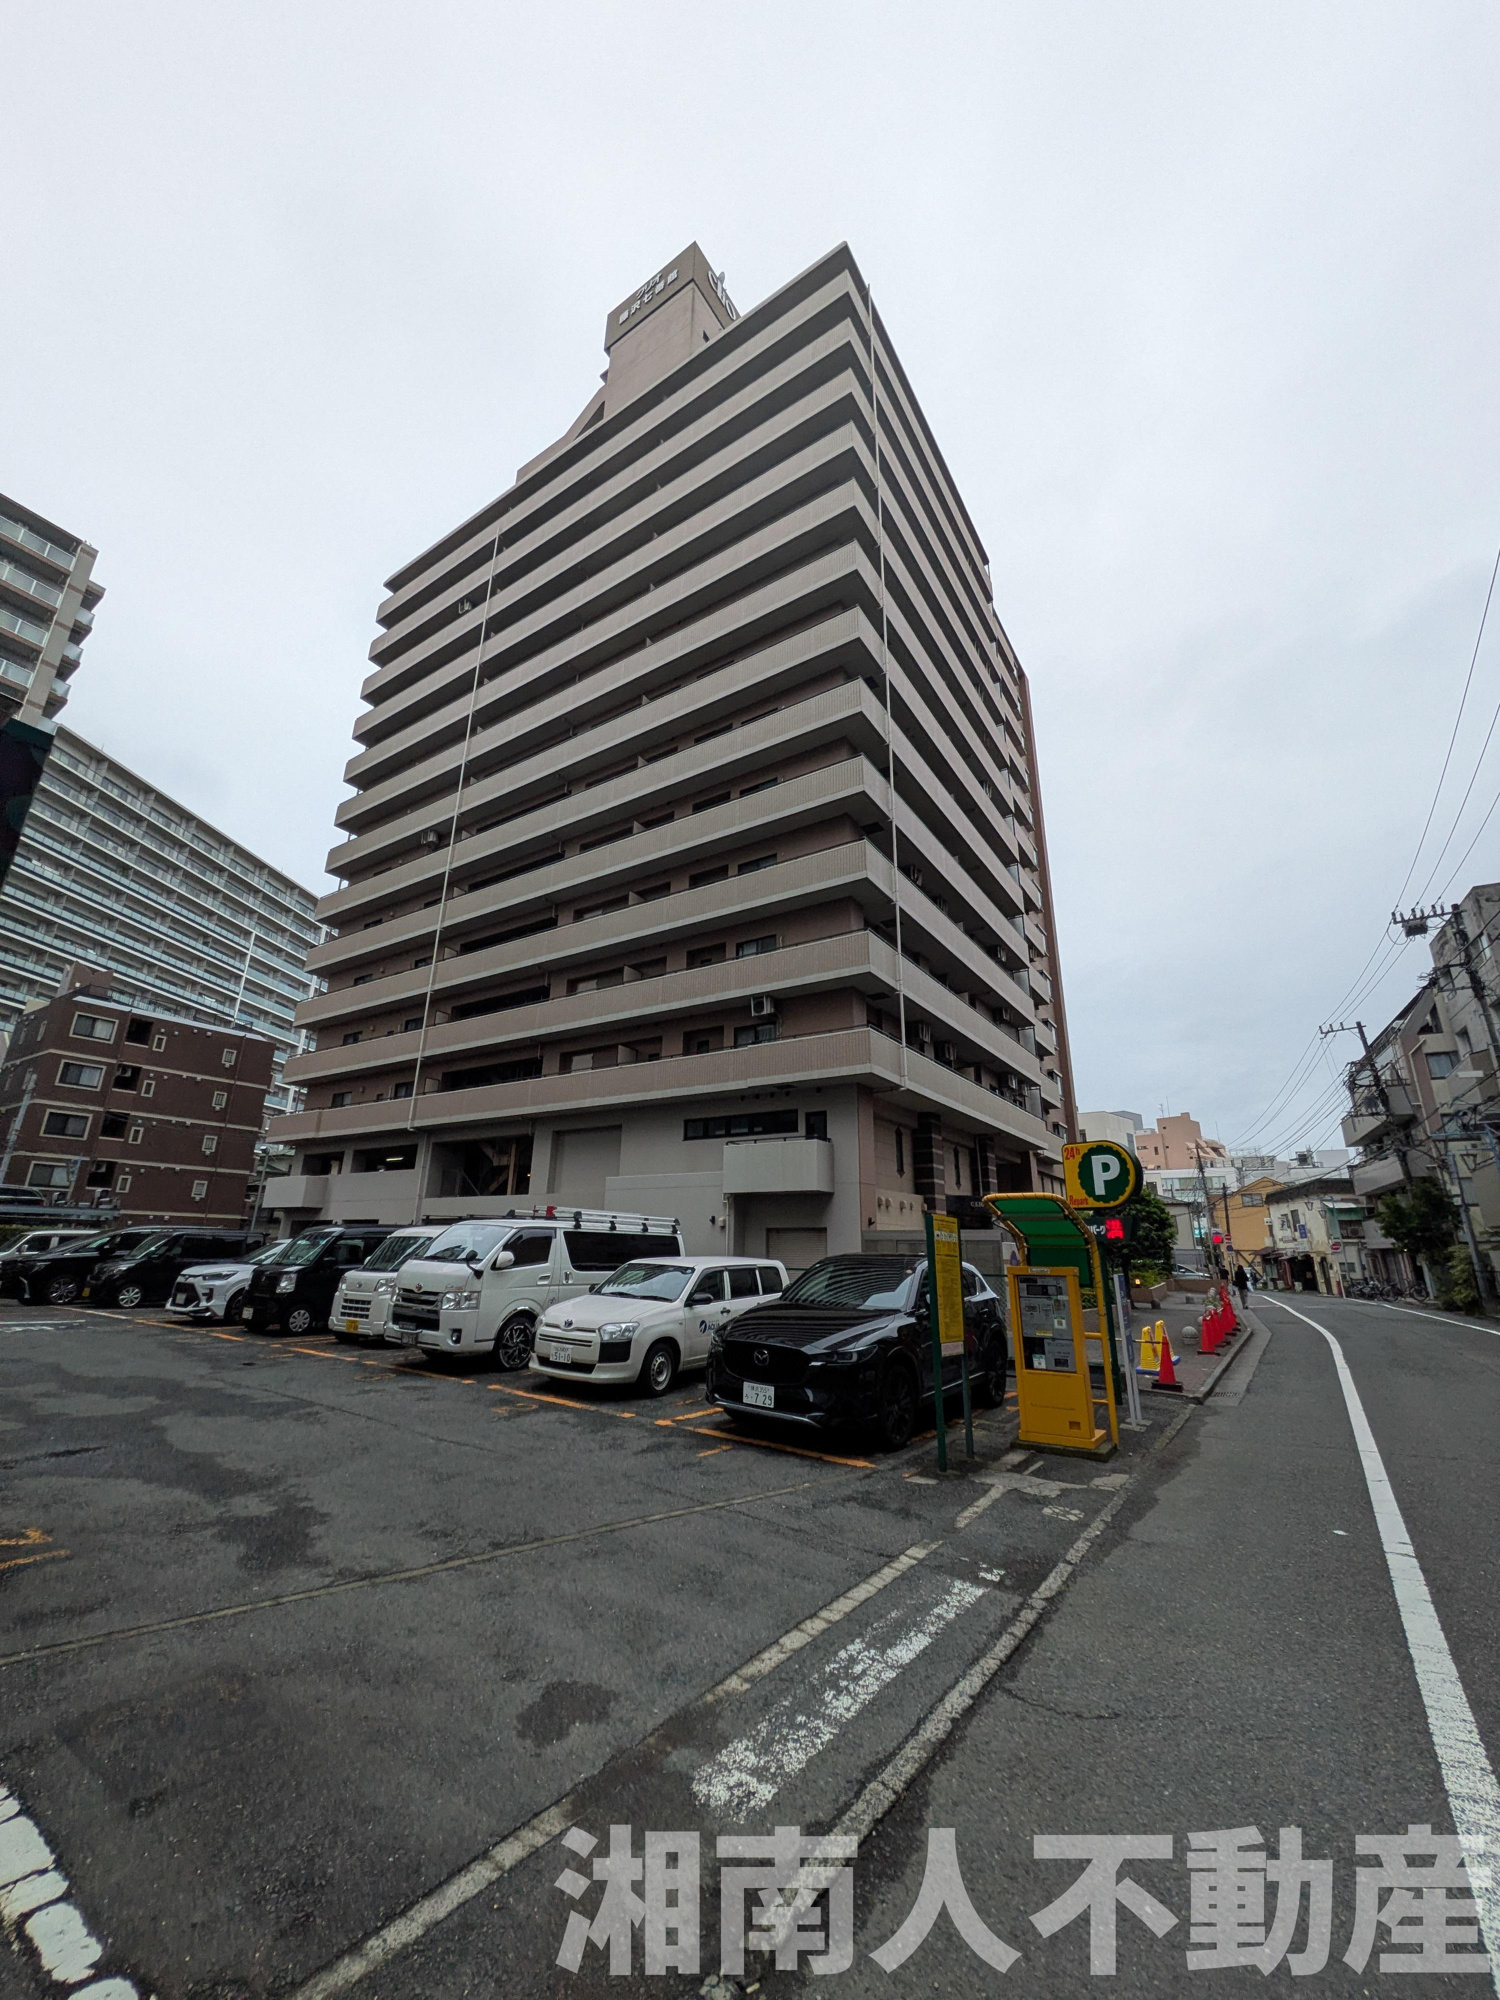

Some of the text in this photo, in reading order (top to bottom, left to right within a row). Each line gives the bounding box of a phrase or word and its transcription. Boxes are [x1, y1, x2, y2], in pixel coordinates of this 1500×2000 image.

[1091, 1154, 1120, 1196] P
[1087, 1224, 1106, 1235] パーク
